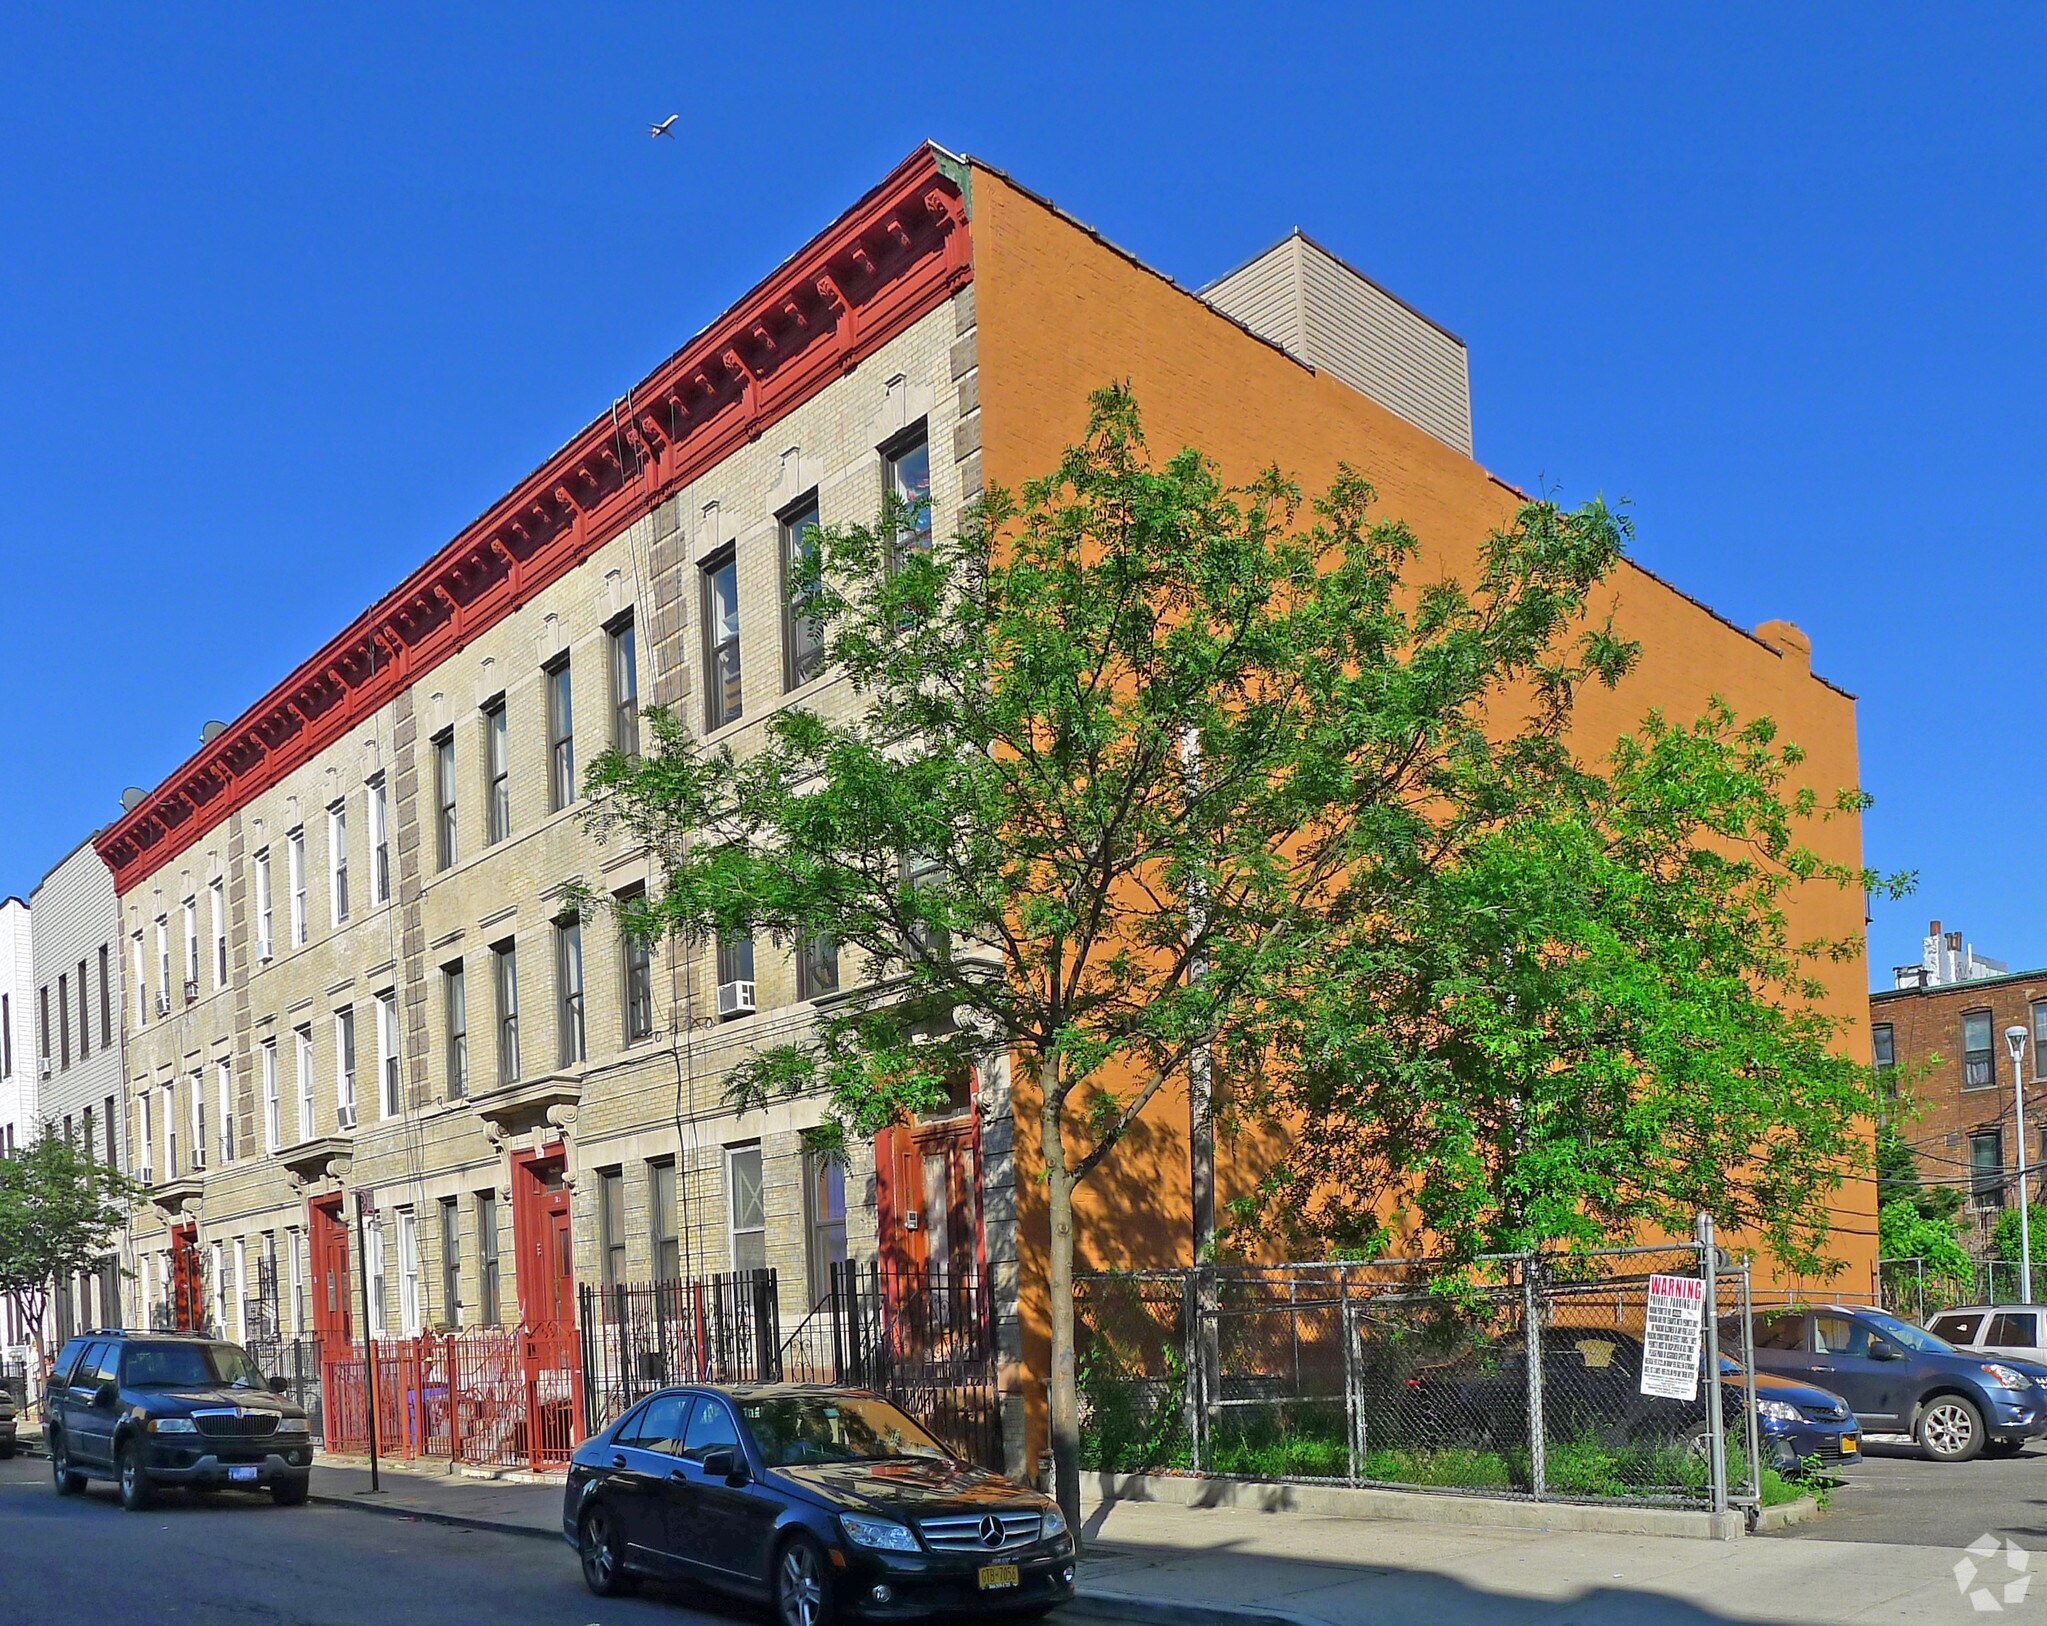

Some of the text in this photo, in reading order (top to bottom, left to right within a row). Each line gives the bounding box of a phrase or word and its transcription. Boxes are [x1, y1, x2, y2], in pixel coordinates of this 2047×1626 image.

[1651, 1276, 1701, 1300] WARNING
[1650, 1294, 1668, 1307] PRIVATE
[1669, 1296, 1690, 1310] PARKING
